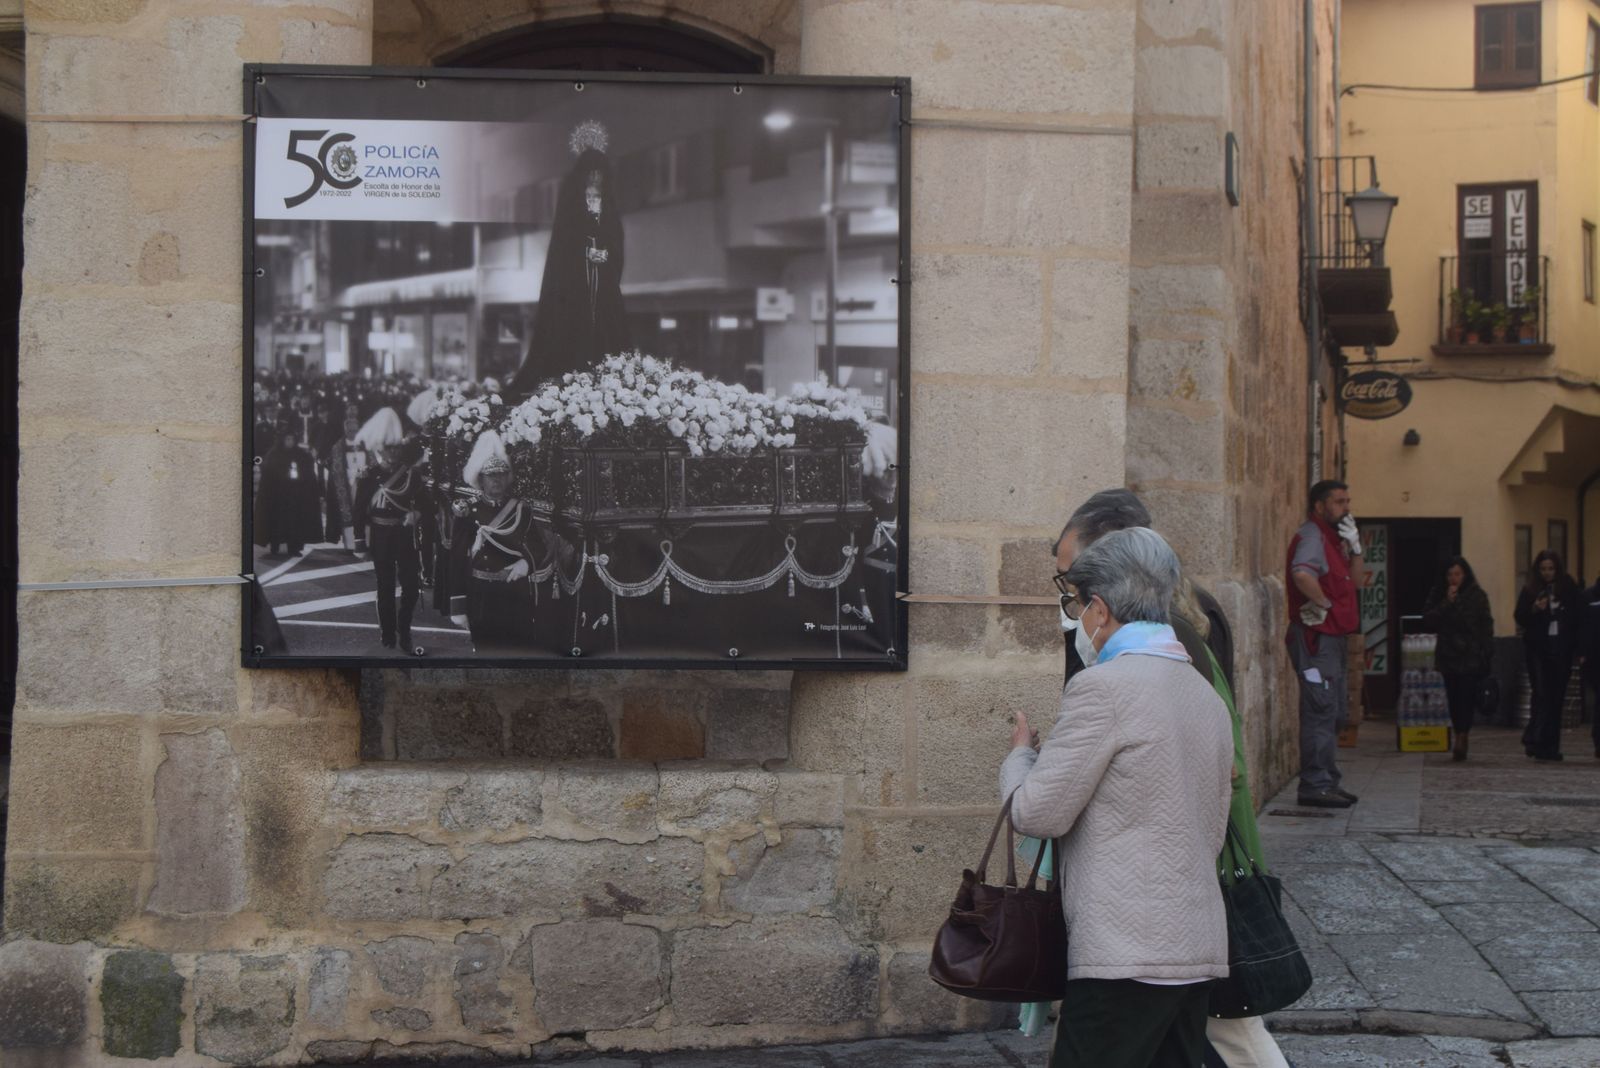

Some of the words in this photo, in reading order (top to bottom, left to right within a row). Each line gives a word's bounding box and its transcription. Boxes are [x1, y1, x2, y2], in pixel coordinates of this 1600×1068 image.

[364, 165, 440, 179] ZAMORA
[1467, 197, 1489, 215] SE
[1510, 192, 1524, 306] VENDE
[1362, 529, 1386, 546] VIA
[1363, 546, 1385, 563] JES
[1363, 571, 1385, 587] ZA
[1363, 587, 1386, 603] MO
[1362, 603, 1386, 620] PORT
